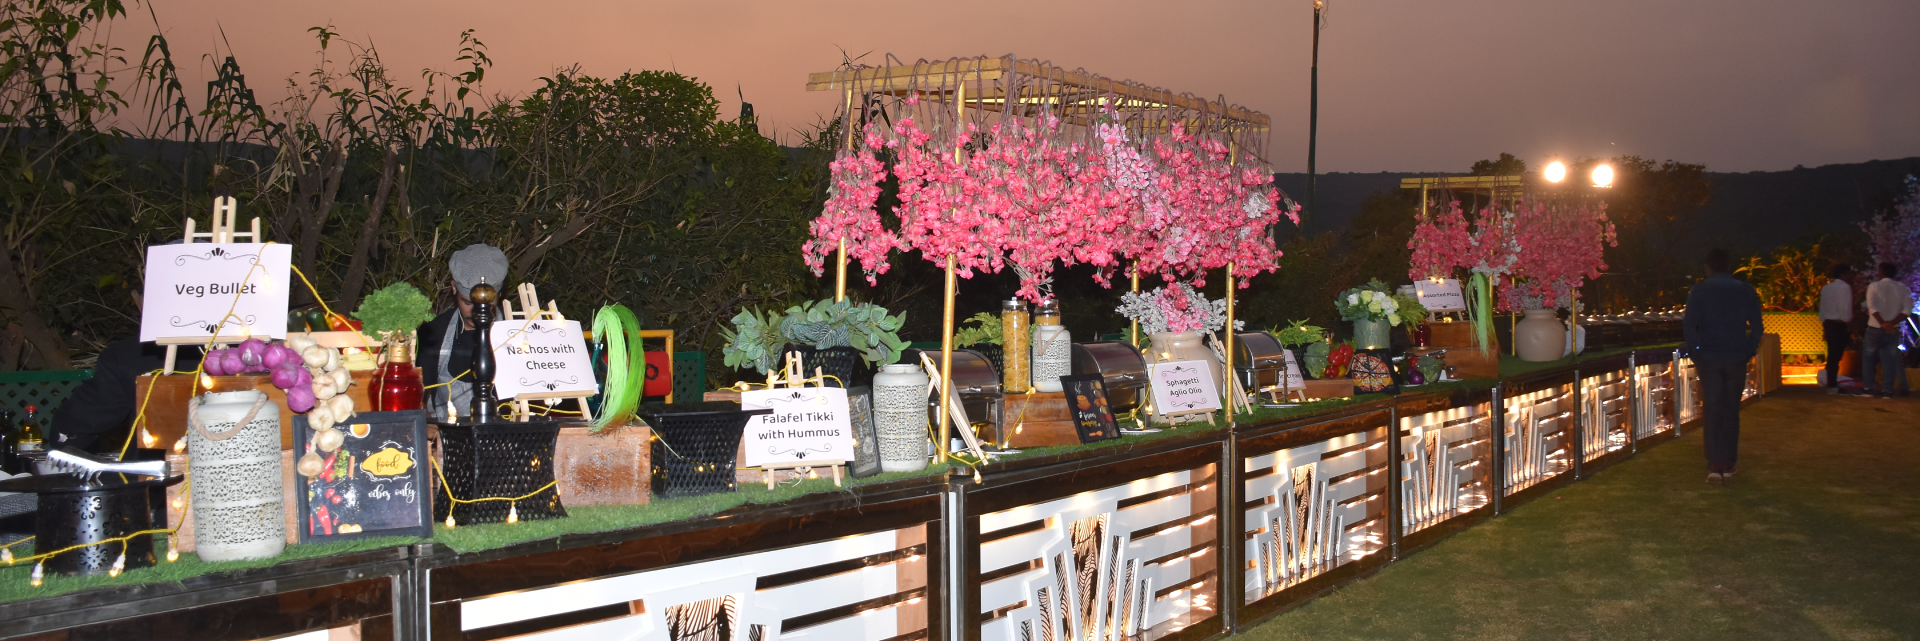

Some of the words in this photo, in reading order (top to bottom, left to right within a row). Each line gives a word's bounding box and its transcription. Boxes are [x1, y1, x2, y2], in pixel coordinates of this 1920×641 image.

[175, 284, 205, 298] Veg
[209, 283, 257, 295] Bullet
[507, 344, 549, 356] Nachos
[552, 343, 576, 354] with
[526, 360, 566, 370] Cheese
[1166, 377, 1199, 387] Sphagetti
[1170, 388, 1188, 398] Aglio
[1188, 386, 1203, 395] Olio
[762, 412, 803, 424] Falafel
[806, 411, 834, 422] Tikki
[758, 429, 785, 440] with
[788, 428, 840, 439] Hummus
[376, 453, 401, 473] food
[368, 483, 392, 502] vibes
[394, 481, 416, 504] only
